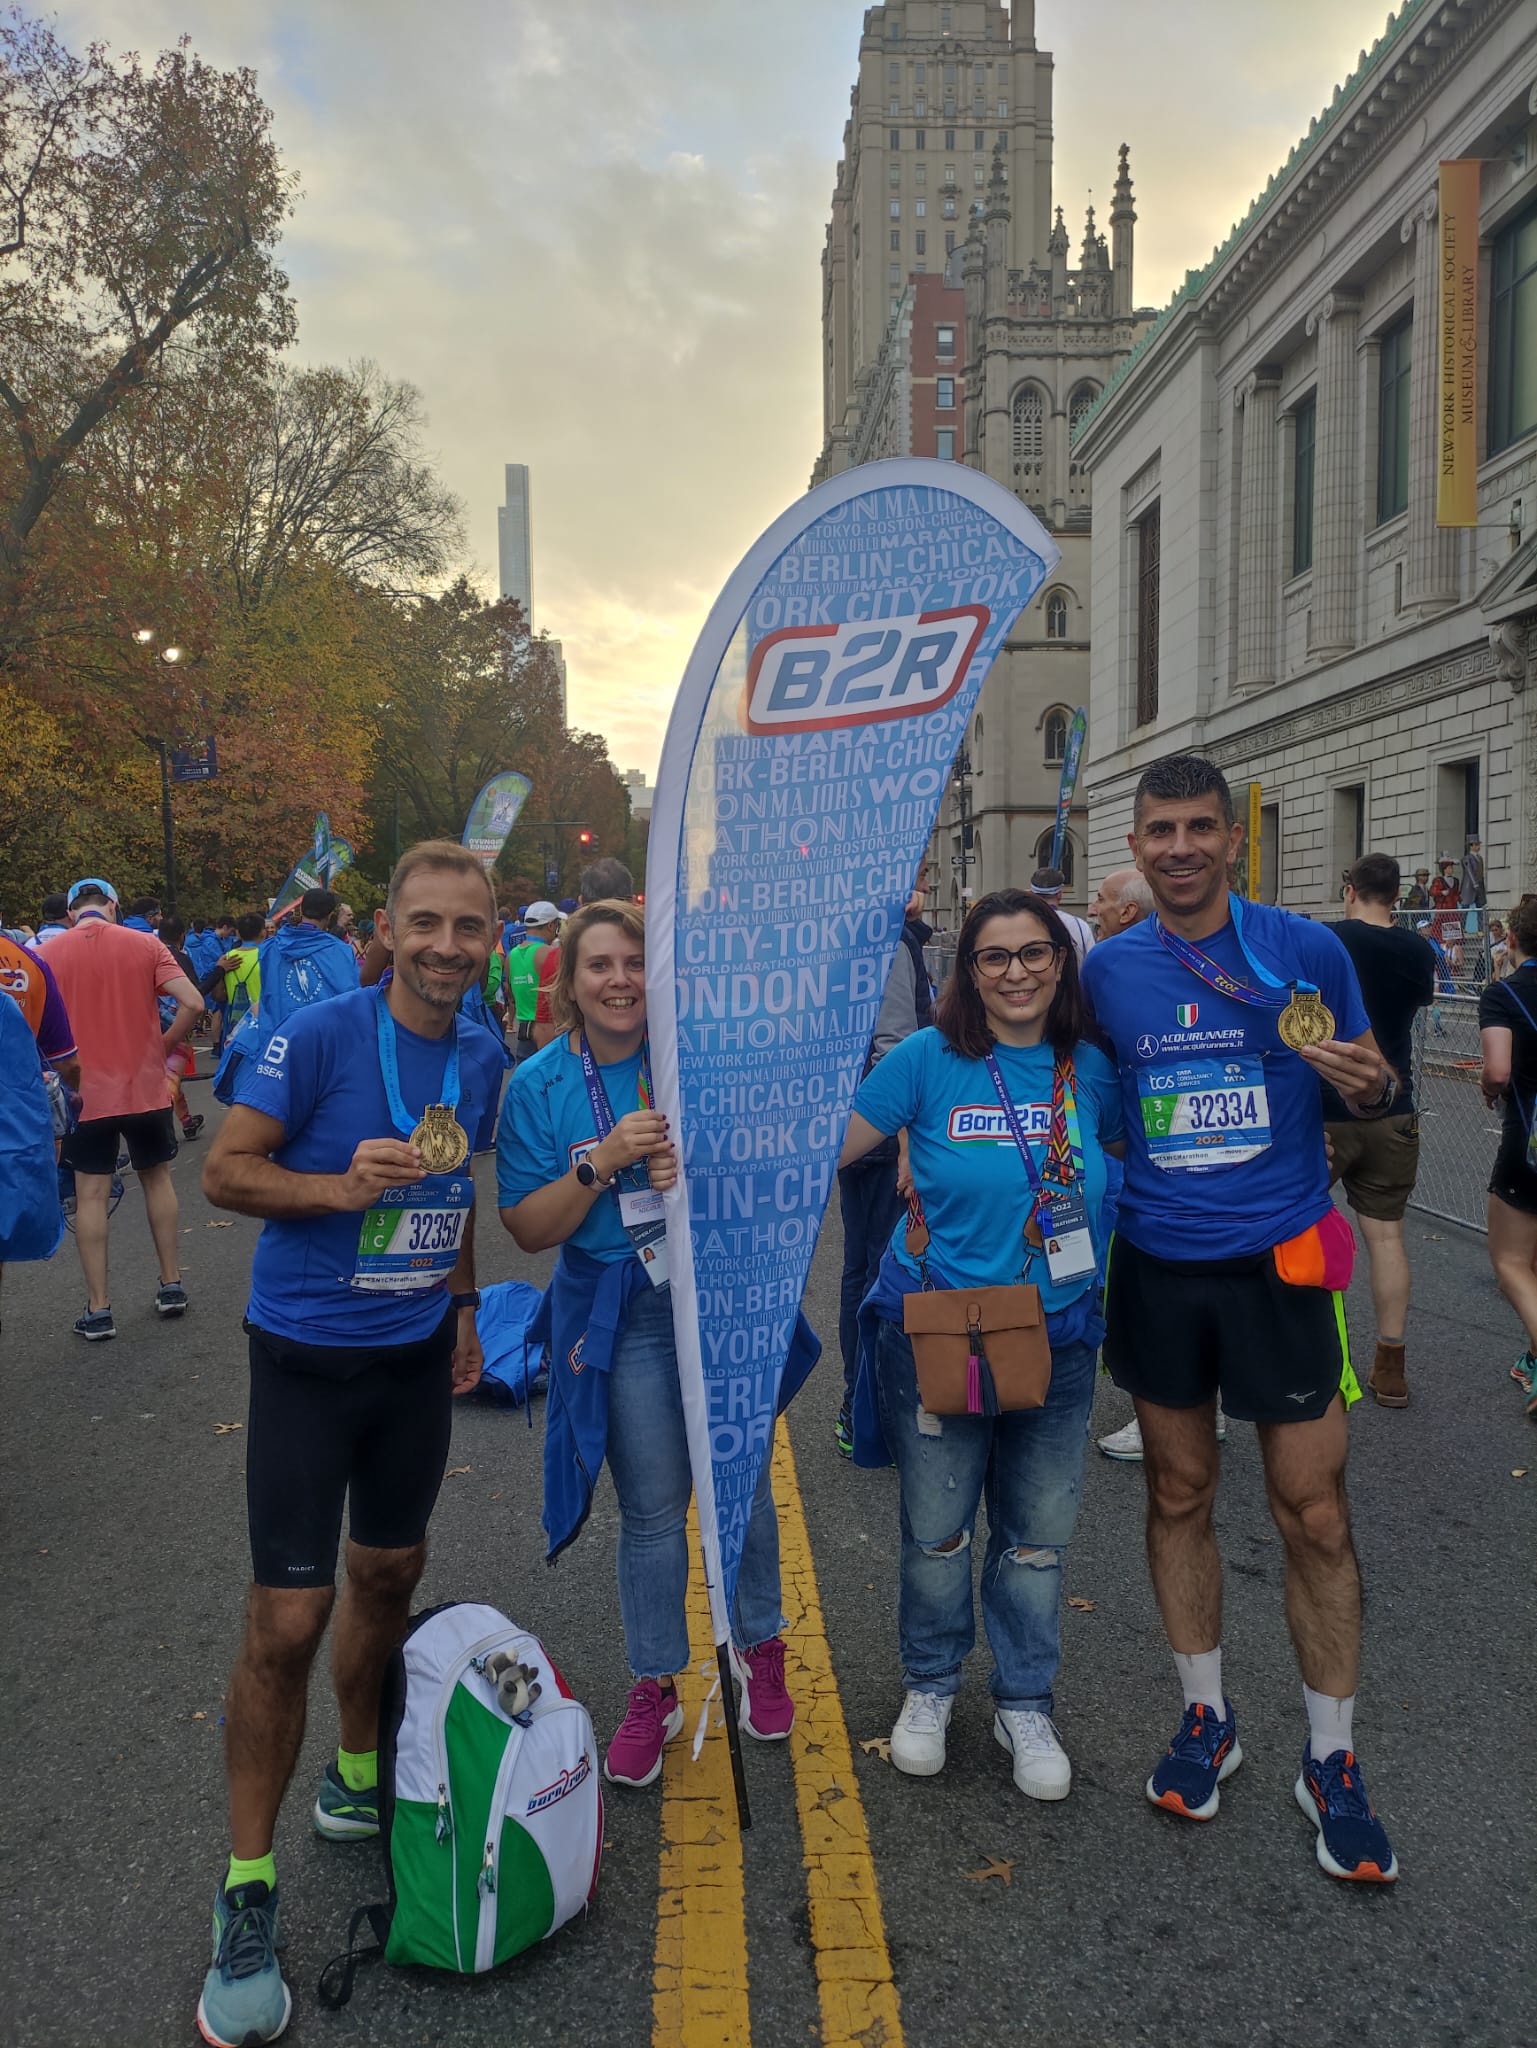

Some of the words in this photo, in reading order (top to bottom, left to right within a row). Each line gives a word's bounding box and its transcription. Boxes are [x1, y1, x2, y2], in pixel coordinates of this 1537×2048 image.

[1444, 213, 1456, 281] SOCIETY
[1463, 265, 1475, 332] LIBRARY
[1444, 287, 1455, 384] HISTORICAL
[1462, 354, 1474, 424] MUSEUM
[1442, 392, 1455, 476] NEW-YORK
[880, 520, 1006, 549] MARATHO
[767, 629, 958, 711] B2R
[1160, 1028, 1245, 1044] ACQUIRUNNERS
[582, 1050, 593, 1077] 2022
[707, 1053, 742, 1068] YORK
[256, 1064, 284, 1081] BSER
[992, 1070, 1001, 1086] TCS
[1223, 1075, 1246, 1083] TATA
[1153, 1099, 1162, 1112] 3
[1189, 1091, 1257, 1129] 32334
[1155, 1118, 1166, 1131] C
[705, 1121, 799, 1163] YORK
[1195, 1134, 1226, 1145] 2022
[1051, 1201, 1072, 1213] 2022
[376, 1213, 386, 1227] 3
[409, 1212, 461, 1250] 32359
[373, 1235, 385, 1248] C
[409, 1258, 433, 1268] 2022
[707, 1257, 741, 1272] YORK
[705, 1319, 791, 1366] YORK
